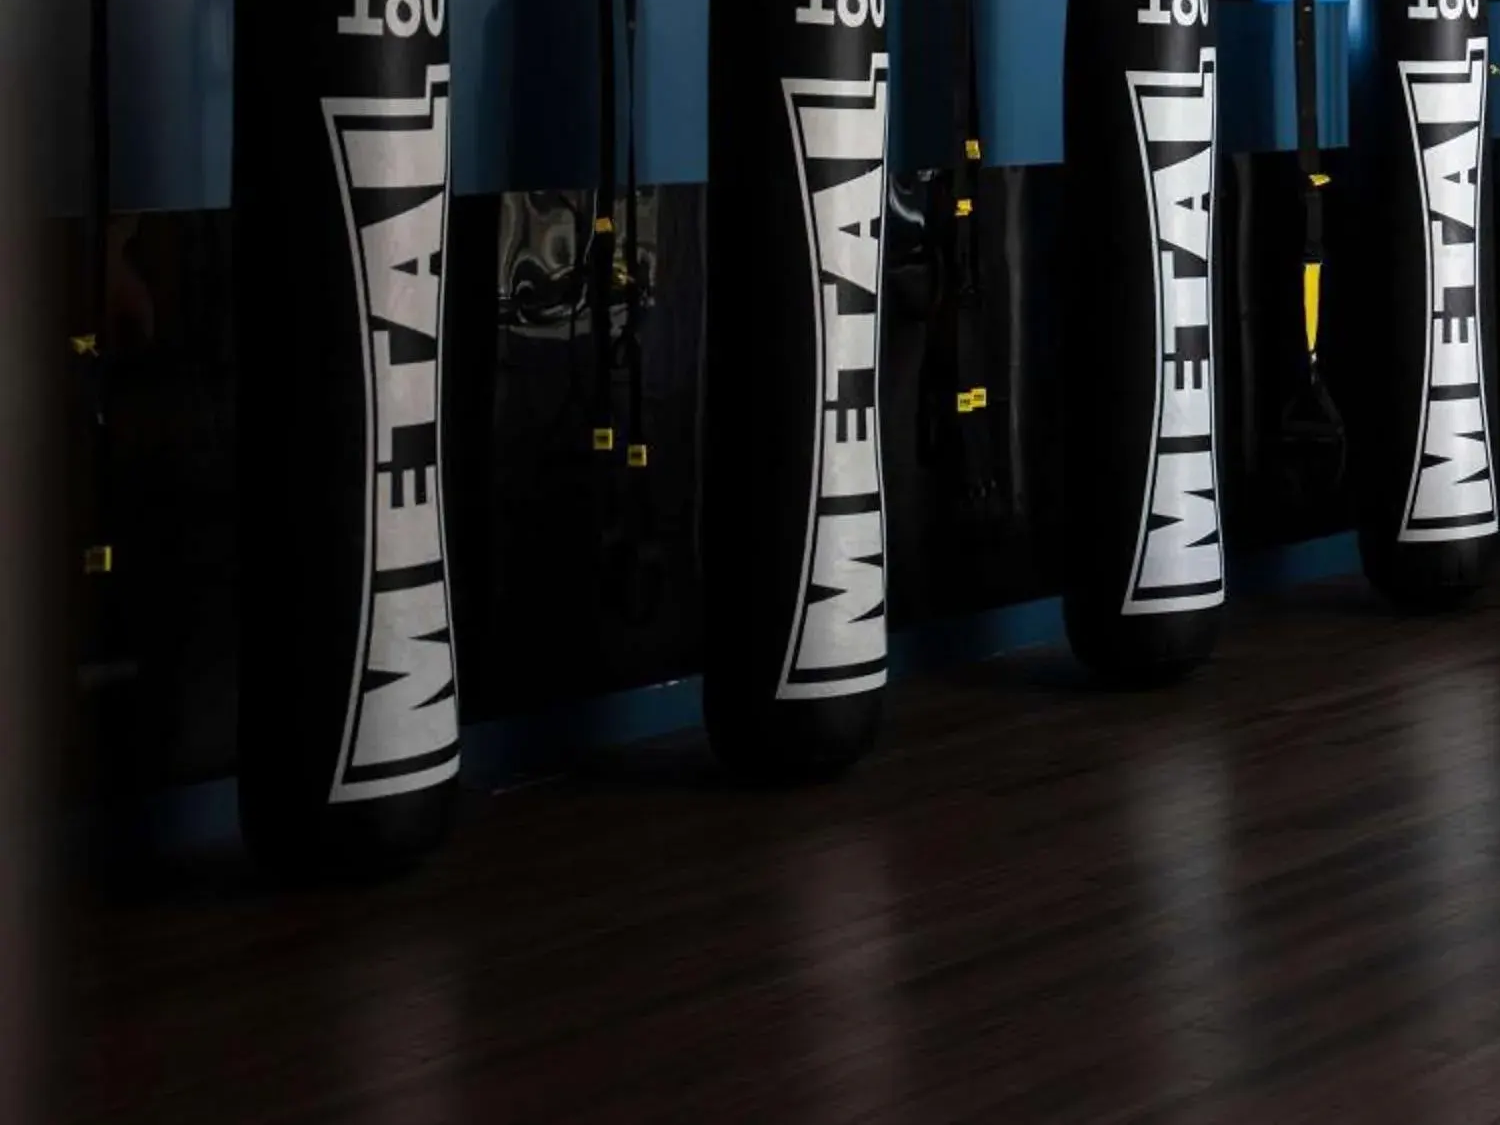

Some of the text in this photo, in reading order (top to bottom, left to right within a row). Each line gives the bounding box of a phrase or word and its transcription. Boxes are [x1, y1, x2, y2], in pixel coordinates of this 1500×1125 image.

[340, 96, 460, 768] METAL
[794, 83, 888, 671] METAL
[1133, 74, 1223, 591] METAL
[1406, 60, 1495, 521] METAL
